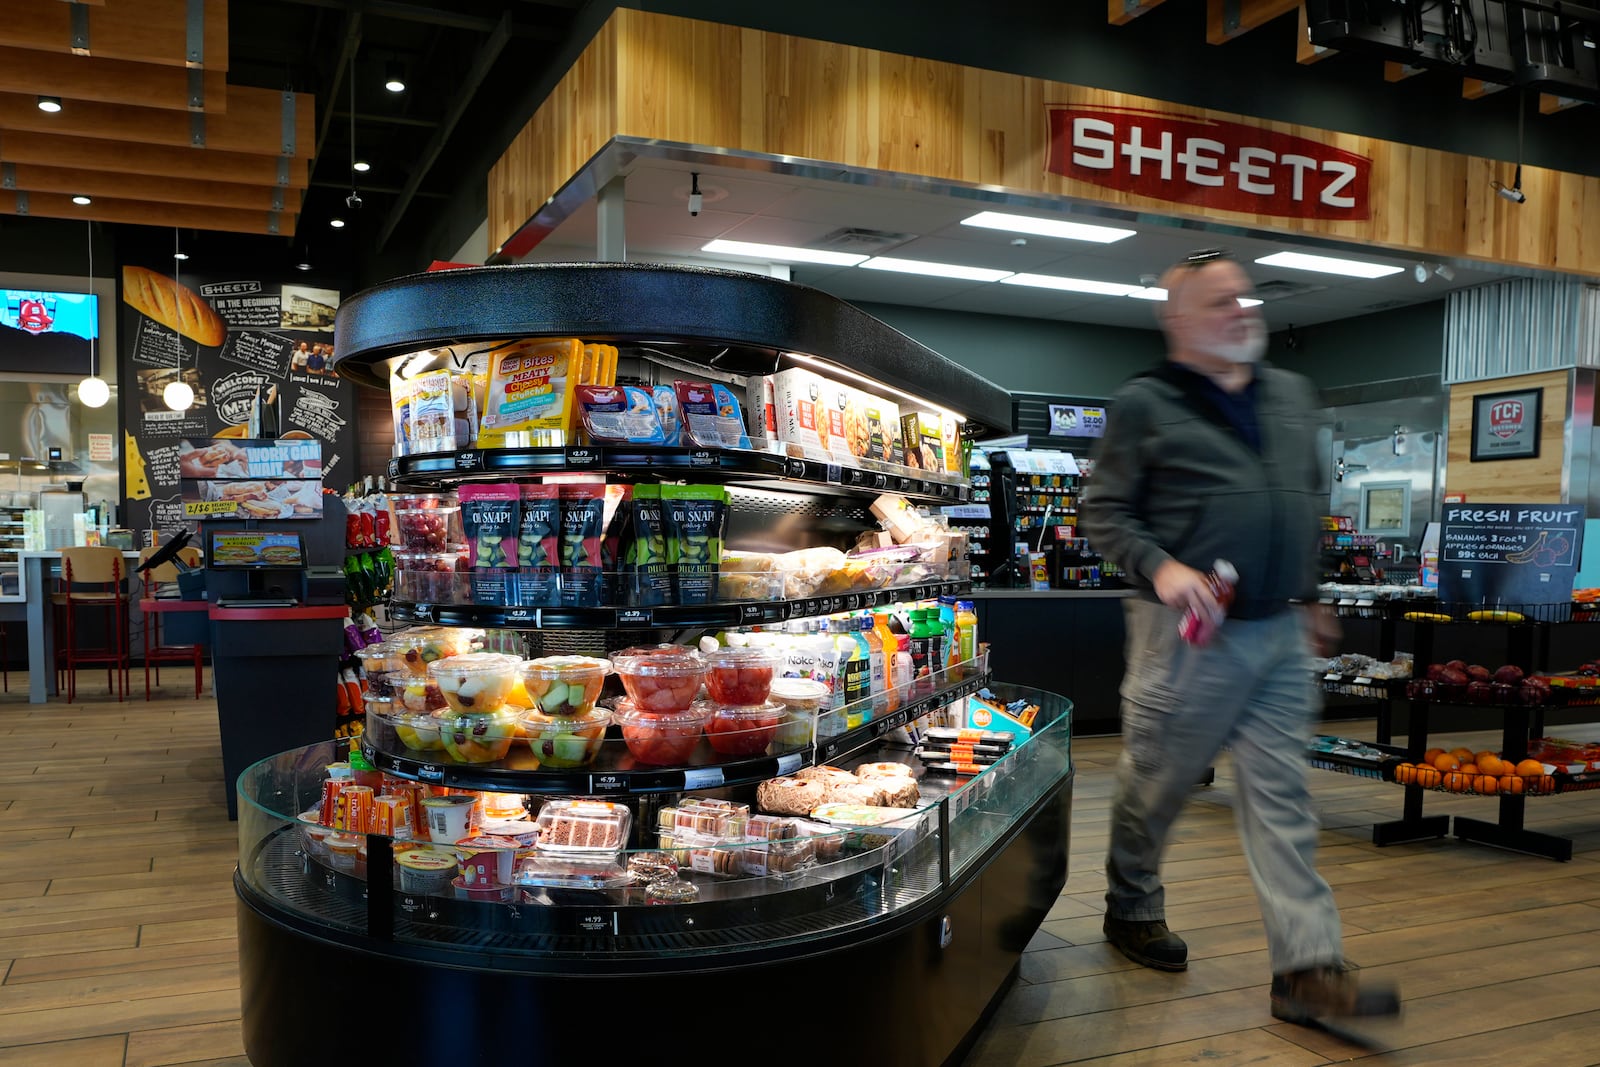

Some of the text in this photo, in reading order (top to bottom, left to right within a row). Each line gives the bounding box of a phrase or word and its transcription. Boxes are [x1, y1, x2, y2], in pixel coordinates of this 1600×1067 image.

[1072, 117, 1357, 208] SHEETZ
[204, 283, 257, 294] SHEETZ
[217, 298, 280, 308] IN THE BEGINNING
[524, 354, 554, 369] Bites
[512, 367, 551, 382] MEATY
[214, 376, 264, 394] WELCOME
[510, 378, 543, 393] Cheesy
[511, 386, 545, 400] Crunchy
[1493, 404, 1521, 420] TCF
[247, 444, 320, 462] WORK CAN
[248, 462, 283, 478] WAIT
[188, 504, 210, 514] 2/$6
[566, 510, 594, 522] SNAP!
[482, 511, 511, 523] SNAP!
[524, 511, 550, 522] SNAP!
[673, 511, 714, 522] OH SNAP!
[1517, 510, 1579, 524] FRUIT
[1518, 535, 1527, 543] $1
